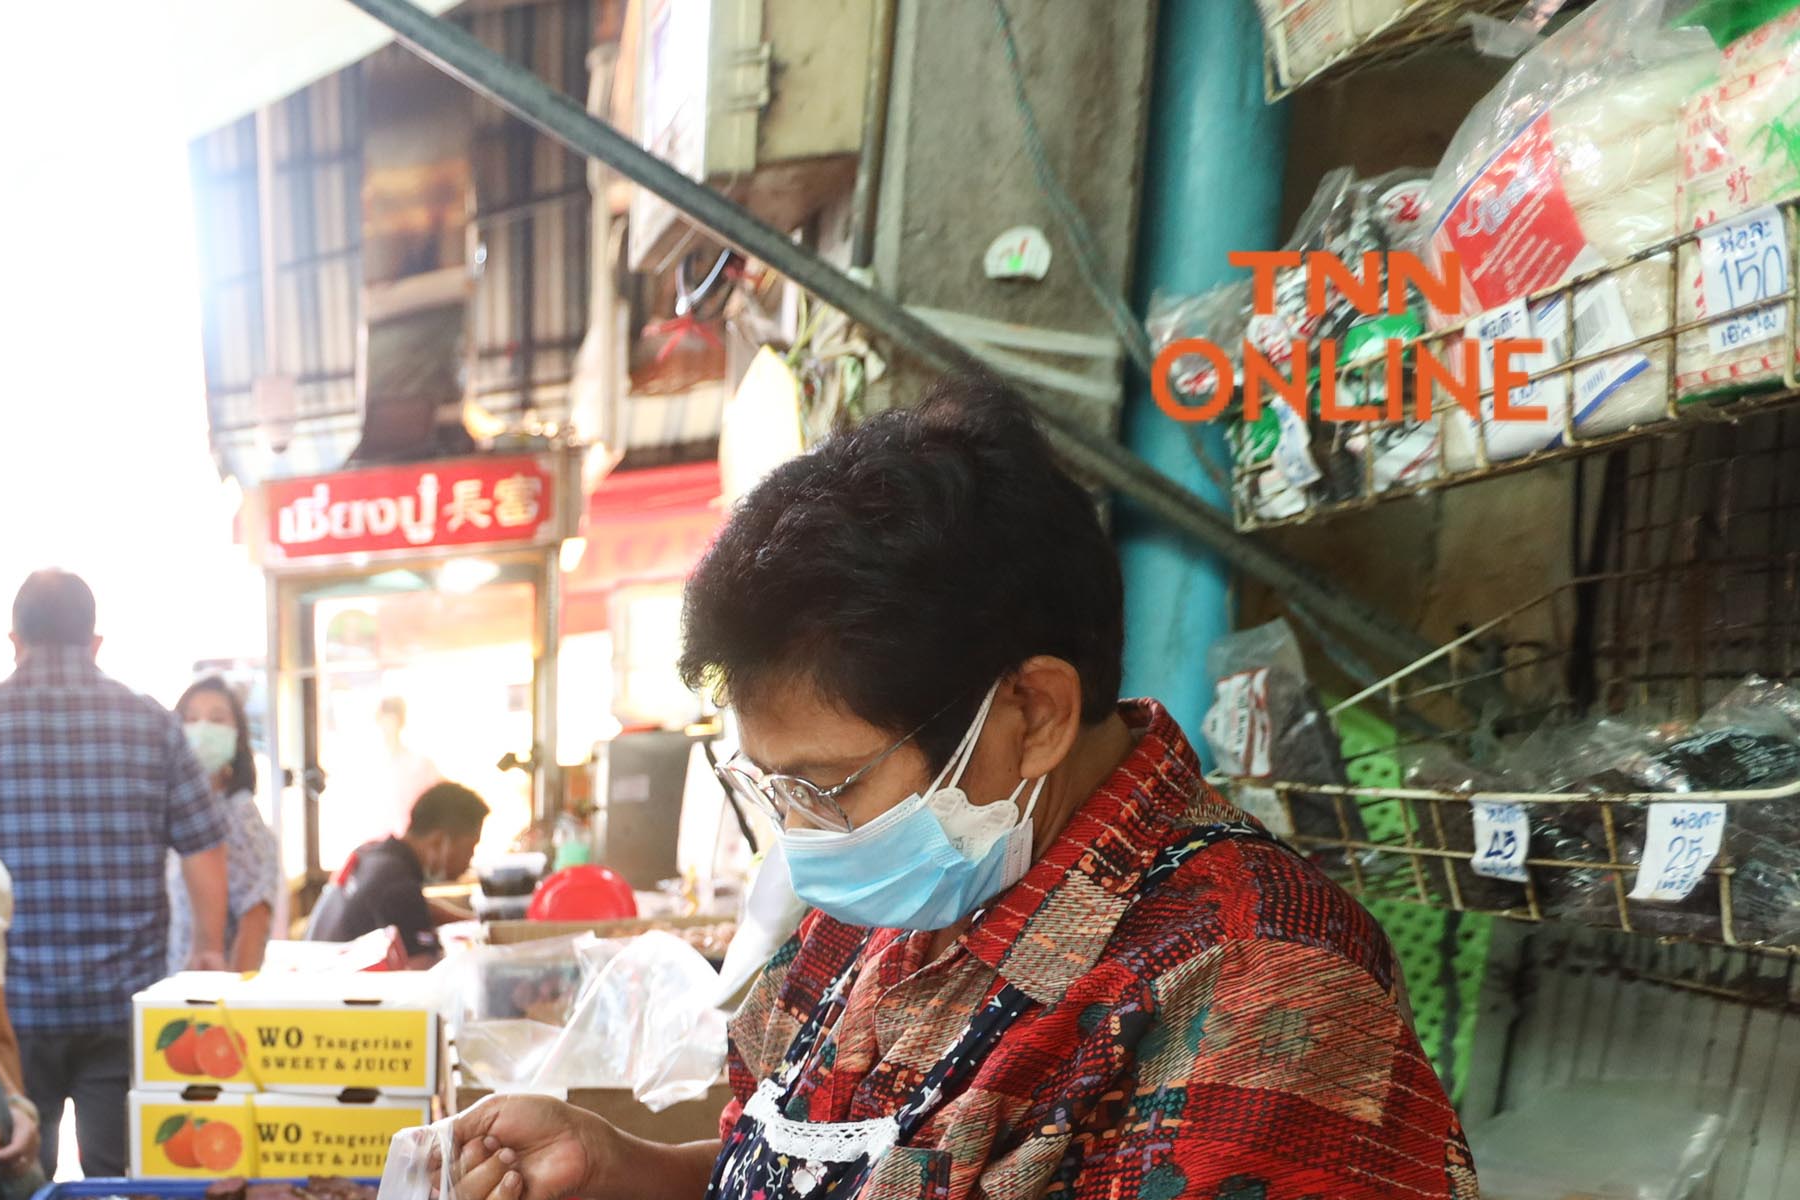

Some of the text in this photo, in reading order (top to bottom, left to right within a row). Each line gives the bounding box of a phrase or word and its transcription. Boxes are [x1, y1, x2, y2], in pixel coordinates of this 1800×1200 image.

[1720, 244, 1786, 310] 150
[256, 1026, 414, 1052] WO Tangerine
[261, 1056, 413, 1072] SWEET & JUICY
[255, 1122, 302, 1144] WO
[261, 1151, 328, 1164] SWEET
[332, 1152, 344, 1165] &
